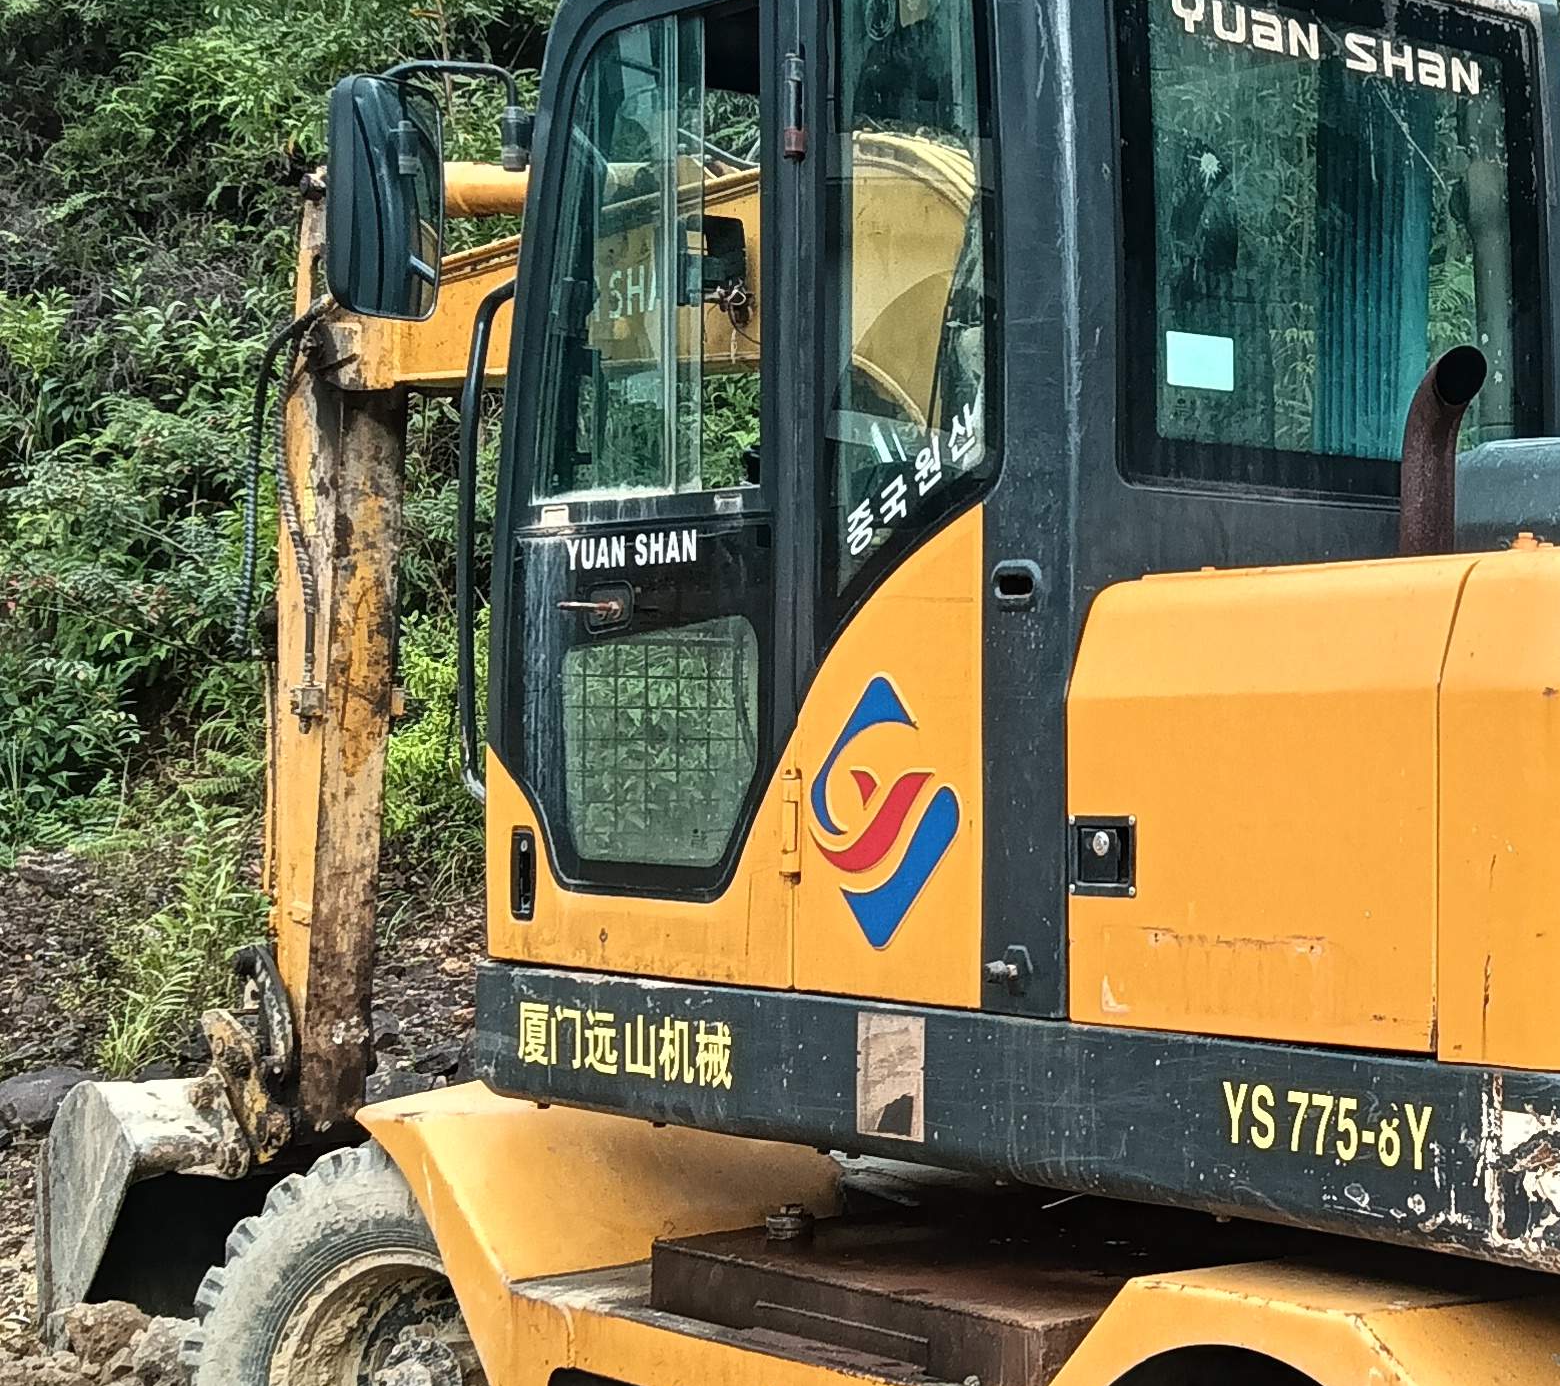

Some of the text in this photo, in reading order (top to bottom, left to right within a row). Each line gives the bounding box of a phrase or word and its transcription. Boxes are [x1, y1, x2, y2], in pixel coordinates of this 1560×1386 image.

[566, 529, 697, 571] YUAN SHAN
[518, 1001, 732, 1090] 厦门远山机械
